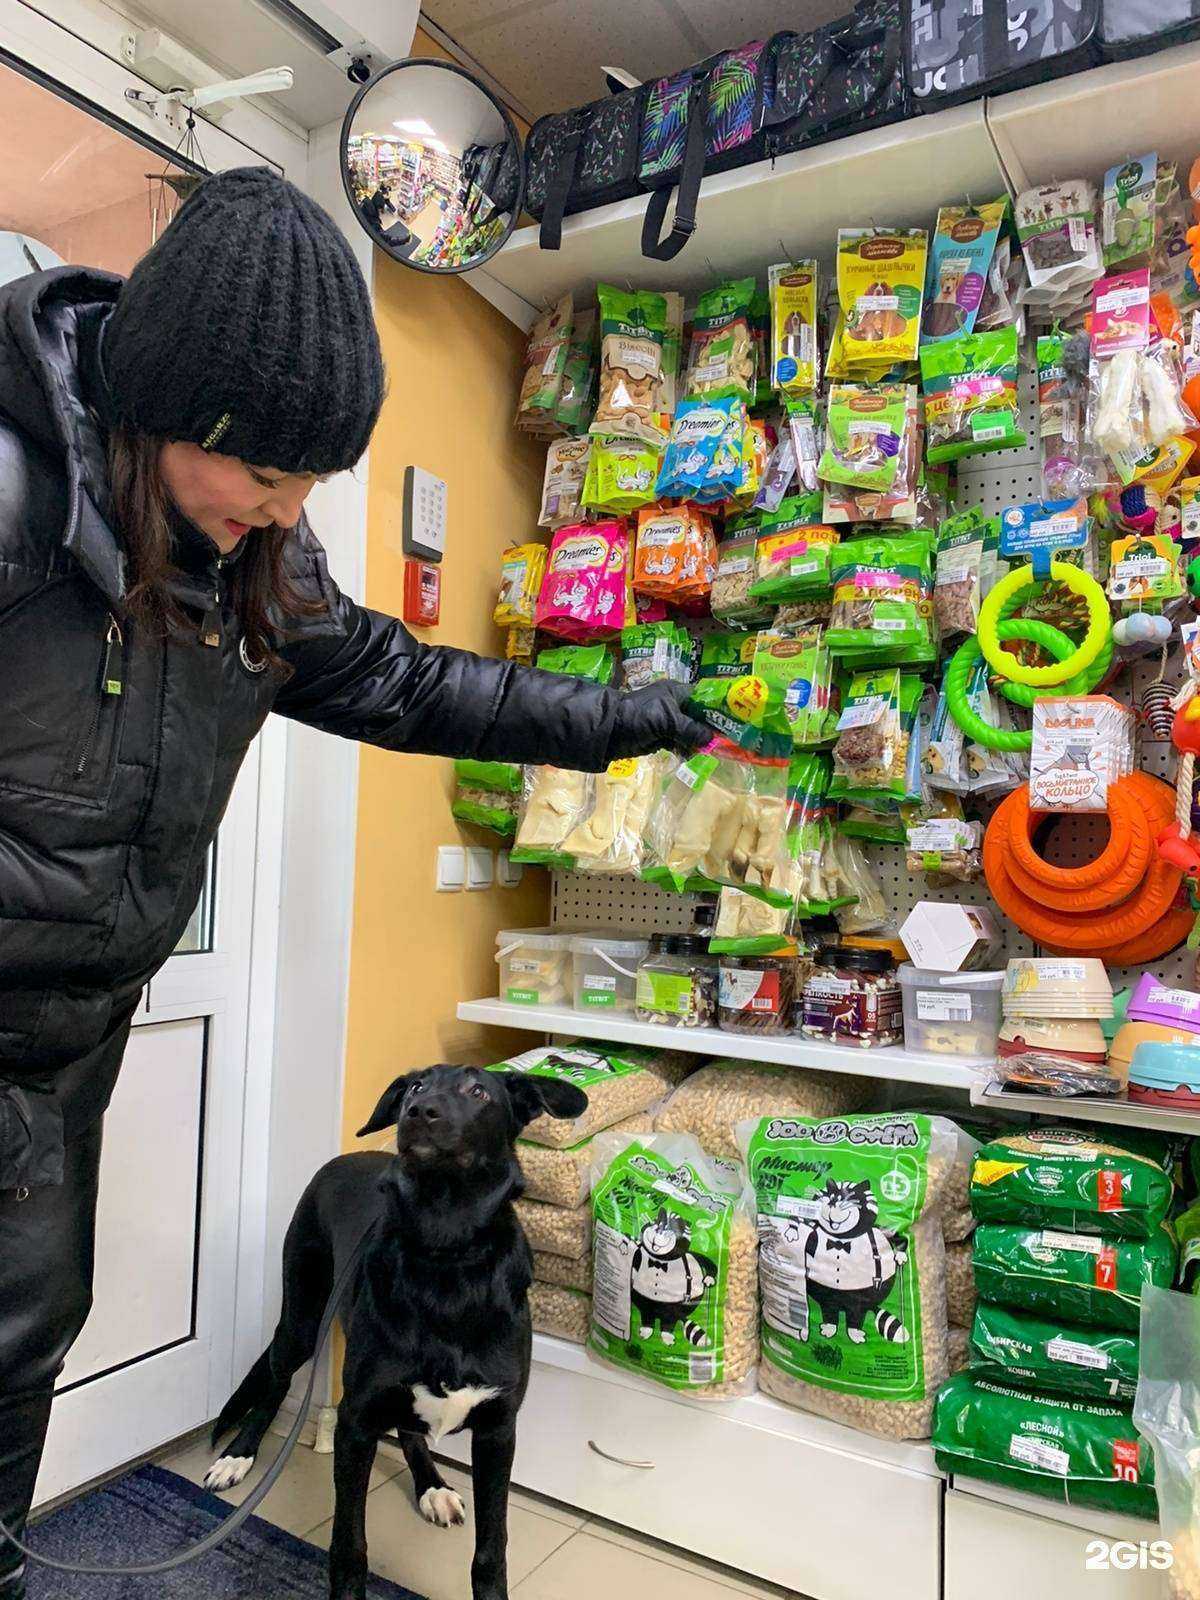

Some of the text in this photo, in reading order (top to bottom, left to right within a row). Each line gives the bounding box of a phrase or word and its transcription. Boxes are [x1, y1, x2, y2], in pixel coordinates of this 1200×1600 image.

[1045, 785, 1091, 798] КОЛЬЦО
[1105, 1180, 1114, 1194] 3
[1101, 1265, 1112, 1283] 7
[1007, 1367, 1037, 1378] КОШКА
[1104, 1378, 1120, 1396] 7
[974, 1380, 1123, 1417] АБСОЛЮТНАЯ ЗАЩИТА ОТ ЗАПАХА
